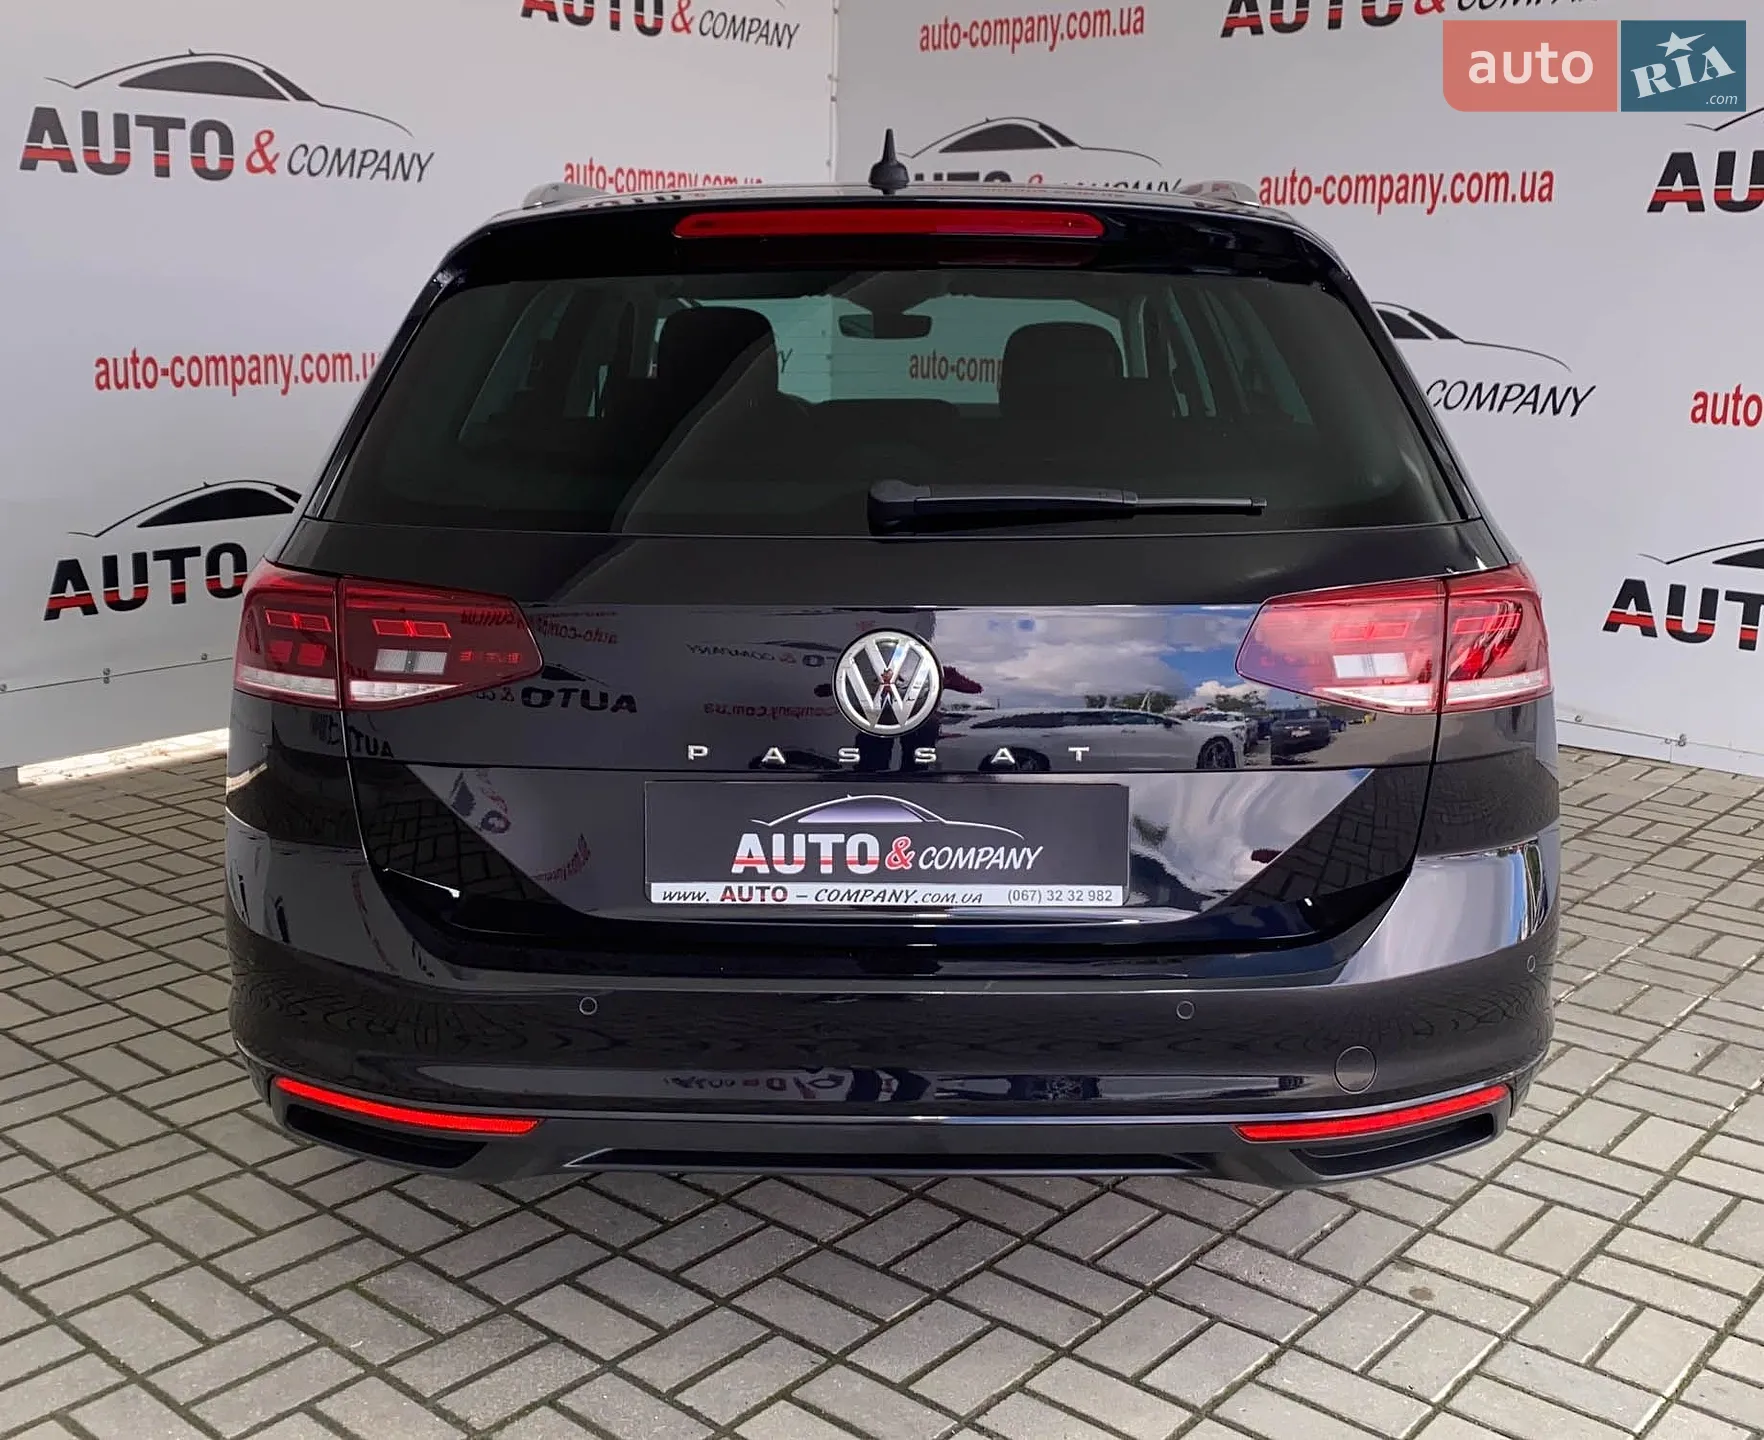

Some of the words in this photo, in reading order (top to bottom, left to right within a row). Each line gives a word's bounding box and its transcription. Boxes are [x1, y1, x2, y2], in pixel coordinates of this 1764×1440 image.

[699, 10, 800, 50] COMPANY
[919, 5, 1145, 54] auto-company.com.ua
[19, 106, 235, 181] AUTO
[244, 130, 281, 175] &
[286, 143, 435, 183] COMPANY
[1258, 168, 1554, 215] auto-company.com.ua
[94, 347, 378, 397] auto-company.com.u
[1426, 379, 1596, 417] COMPANY
[43, 542, 248, 620] AUTO
[687, 744, 1090, 764] PASSAT
[731, 833, 880, 874] AUTO
[885, 836, 912, 870] &
[918, 846, 1043, 870] COMPANY
[720, 885, 788, 902] AUTO
[1007, 889, 1042, 904] (067)
[1047, 889, 1062, 902] 32
[1068, 889, 1083, 902] 32
[1088, 889, 1112, 902] 982
